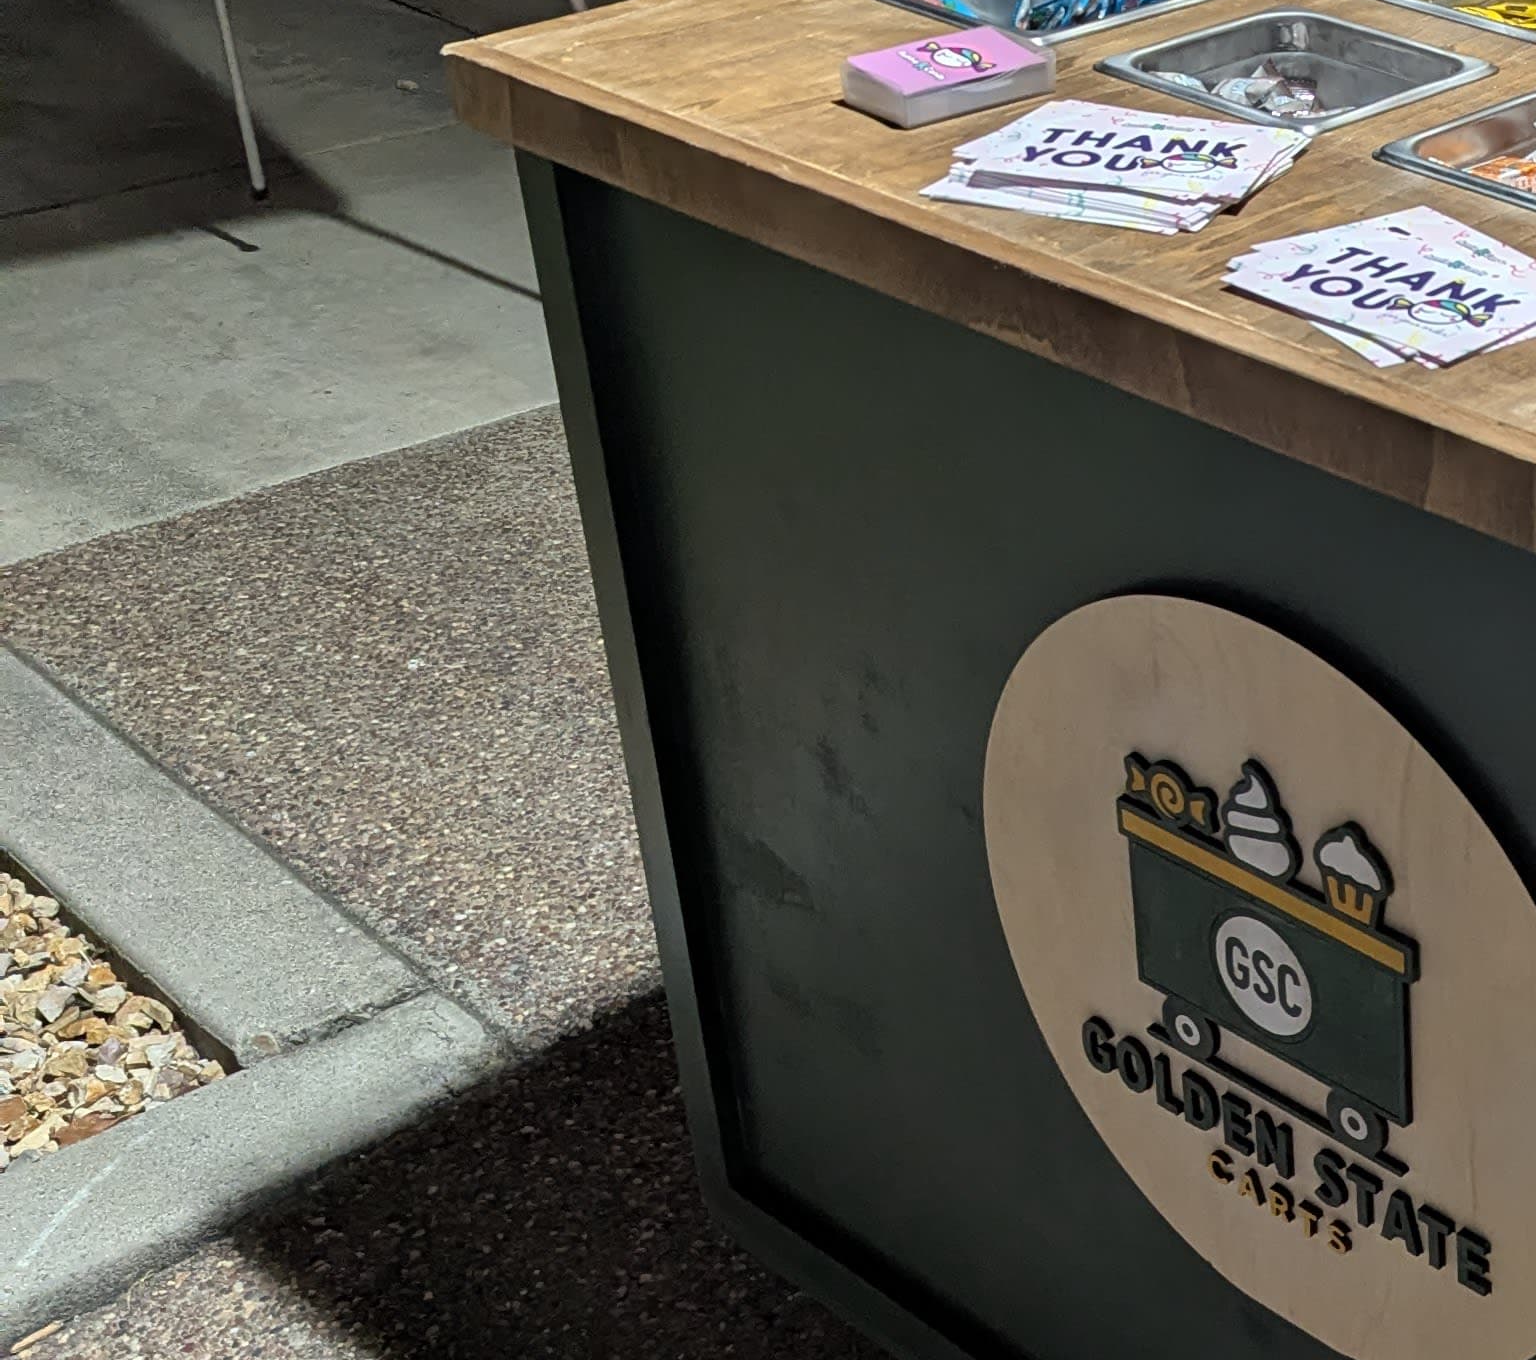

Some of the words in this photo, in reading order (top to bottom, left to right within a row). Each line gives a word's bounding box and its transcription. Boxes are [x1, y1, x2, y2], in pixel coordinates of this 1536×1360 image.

[1022, 145, 1146, 172] YOU
[1042, 127, 1249, 158] THANK
[1282, 263, 1405, 310] YOU
[1326, 246, 1521, 313] THANK
[1223, 935, 1303, 1018] GSC
[1081, 1014, 1296, 1180] GOLDEN
[1313, 1148, 1493, 1298] STATE
[1207, 1148, 1353, 1256] CARTS
